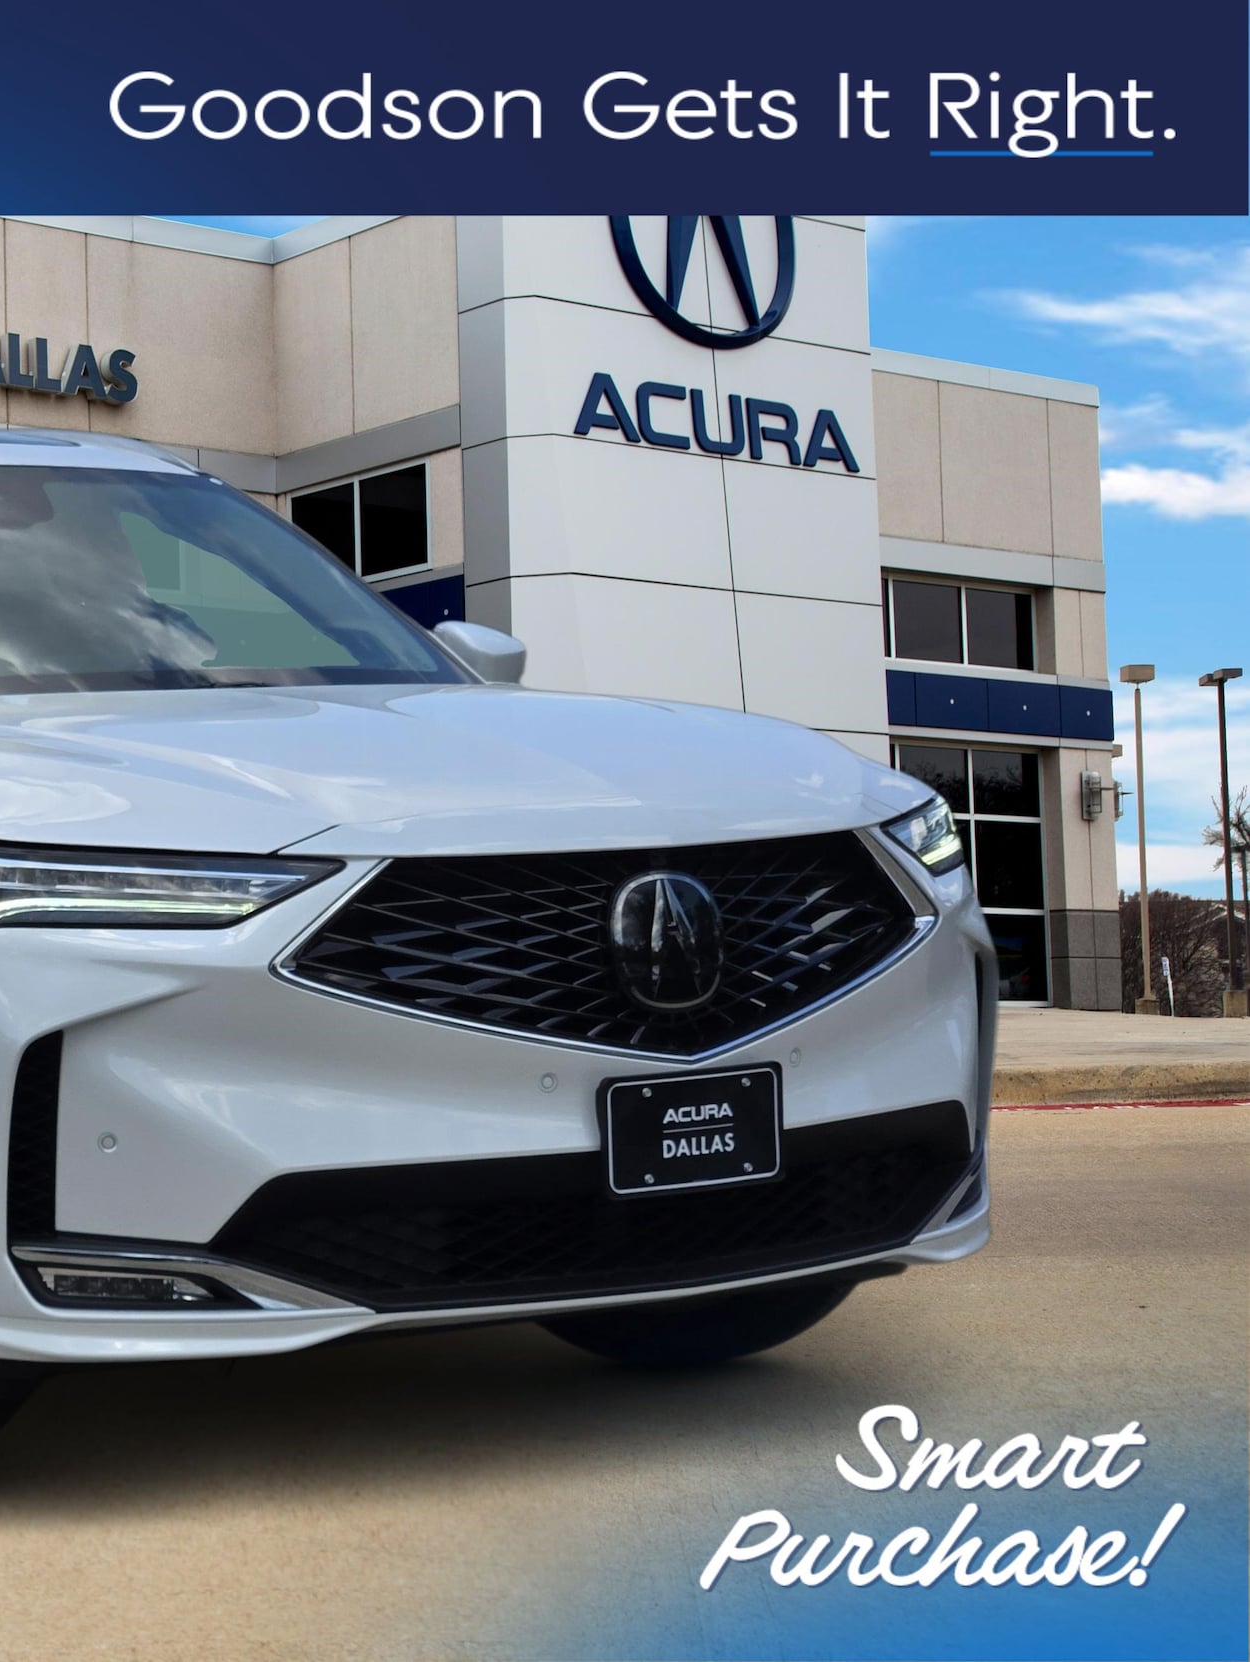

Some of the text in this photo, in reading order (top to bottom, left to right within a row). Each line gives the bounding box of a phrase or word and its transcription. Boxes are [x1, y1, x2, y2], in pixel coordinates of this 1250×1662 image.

[574, 372, 861, 474] ACURA
[662, 1102, 733, 1124] ACURA
[662, 1132, 735, 1159] DALLAS
